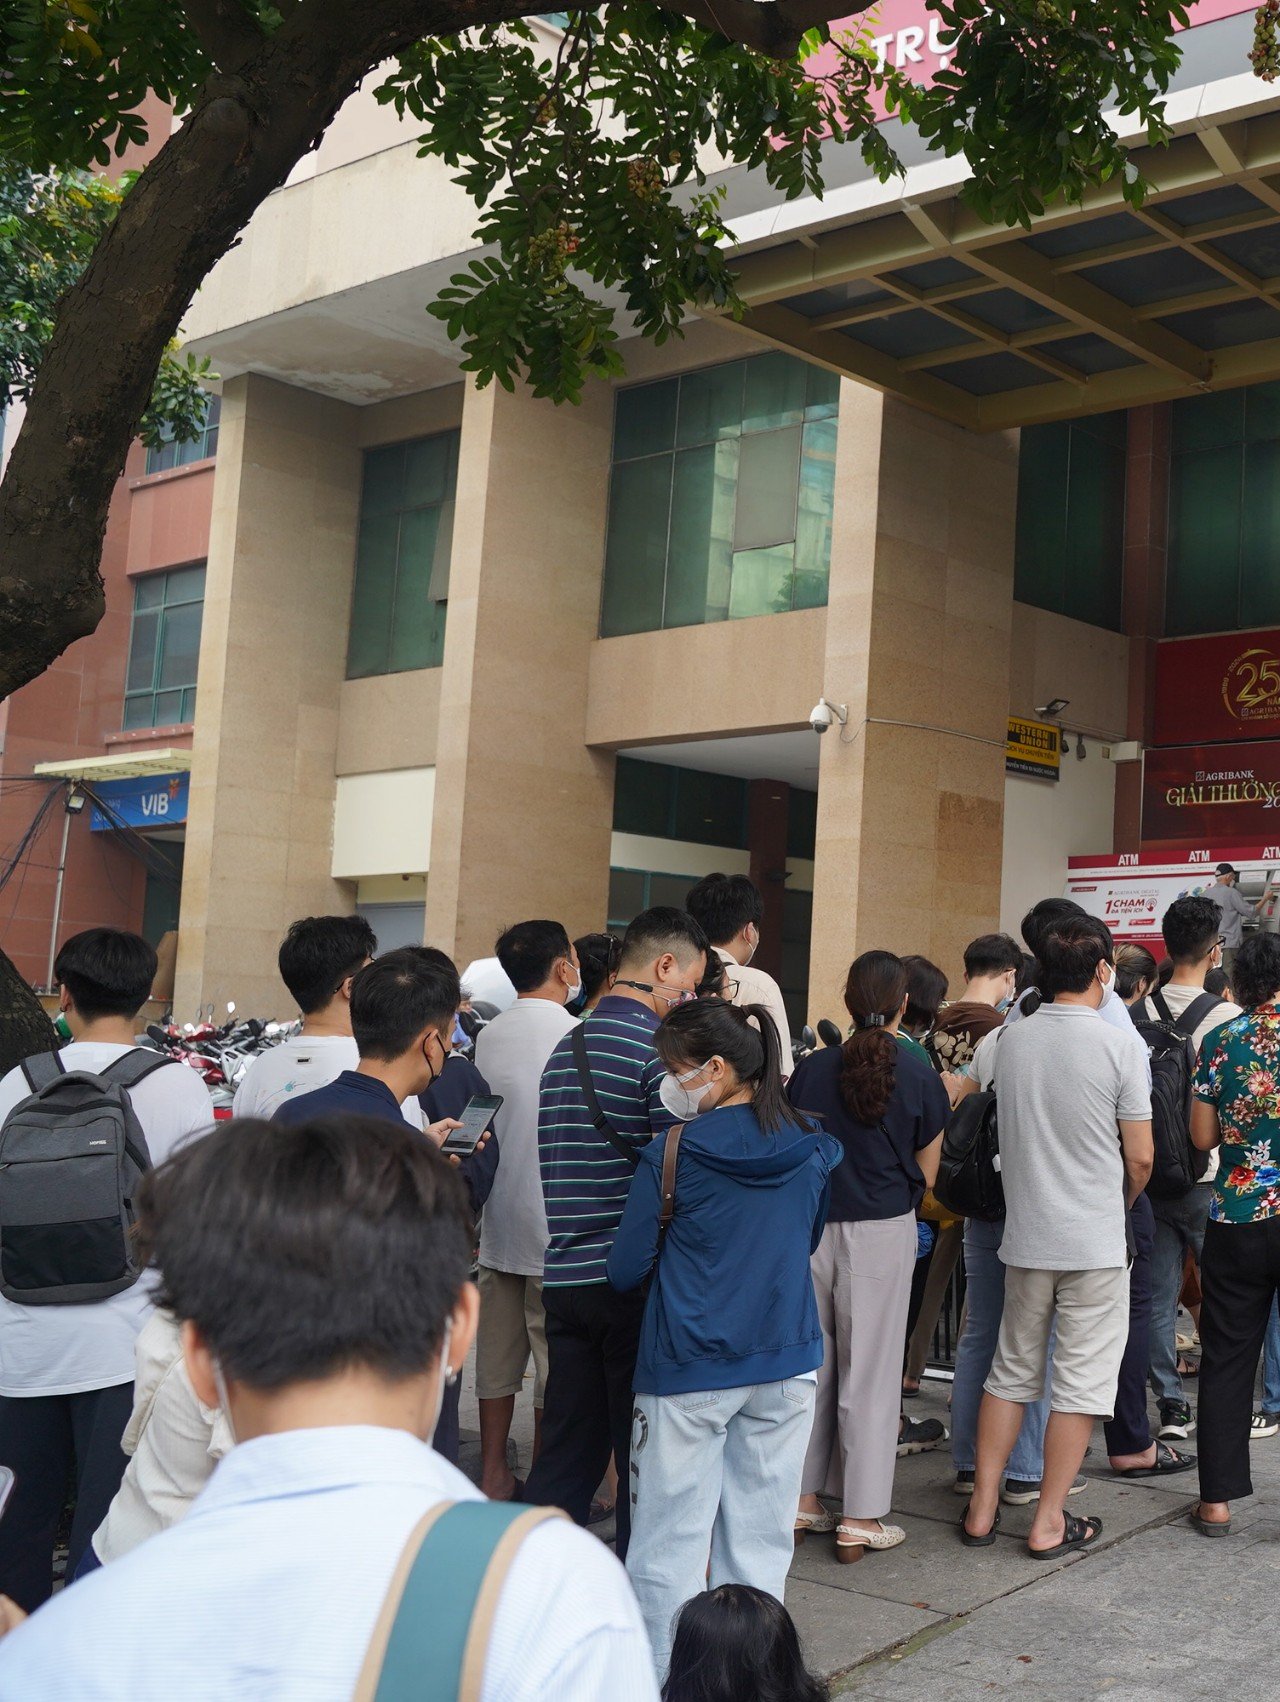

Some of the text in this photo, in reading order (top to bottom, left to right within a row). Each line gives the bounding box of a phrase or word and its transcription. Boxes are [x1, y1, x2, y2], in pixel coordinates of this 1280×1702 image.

[1236, 660, 1280, 708] 25
[1020, 734, 1048, 749] UNION
[1206, 770, 1254, 781] AGRIBANK
[1166, 782, 1204, 807] GIẢI
[141, 792, 169, 816] VIB
[1118, 853, 1139, 867] ATM
[1188, 850, 1210, 863] ATM
[1105, 900, 1112, 915] 1
[1113, 898, 1145, 909] CHẠM
